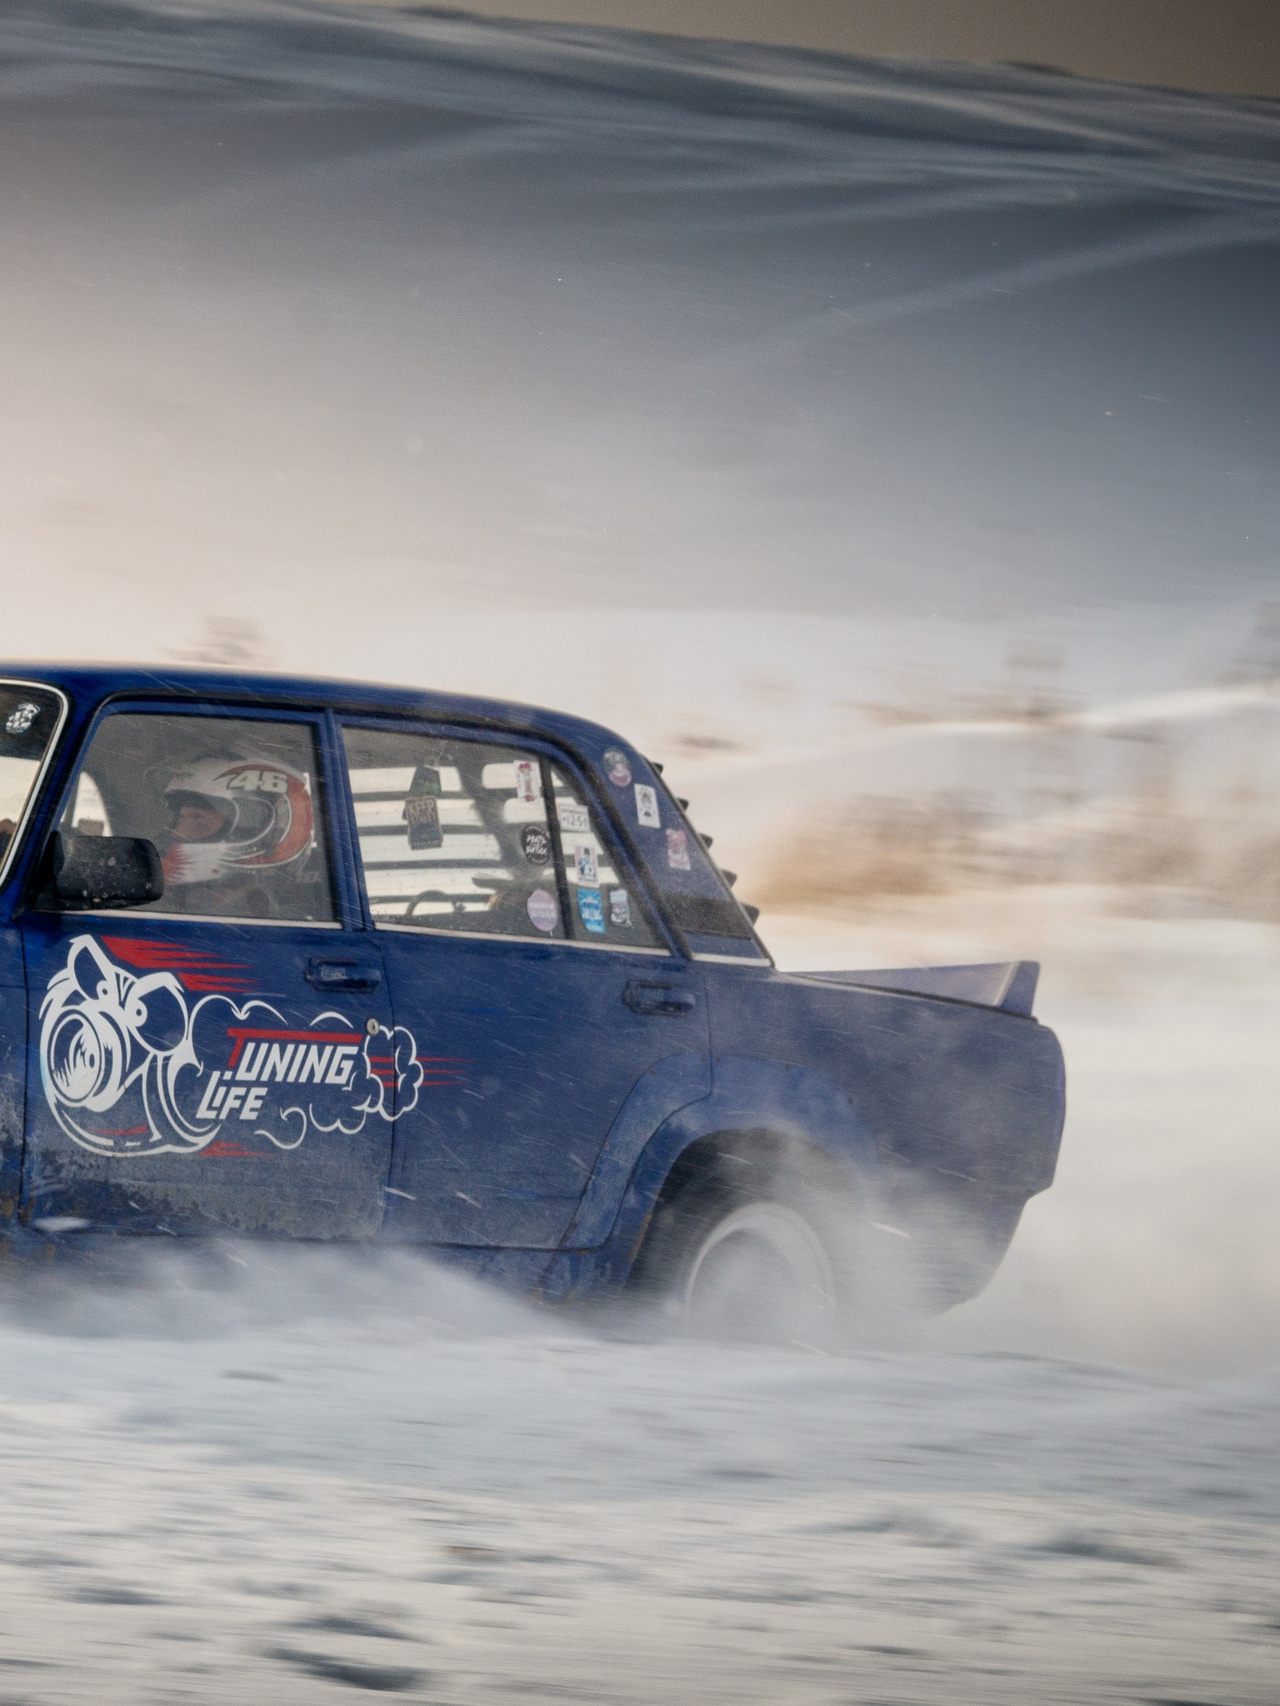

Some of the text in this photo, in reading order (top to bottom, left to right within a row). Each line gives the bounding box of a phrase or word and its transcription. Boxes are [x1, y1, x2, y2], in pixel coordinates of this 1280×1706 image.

[229, 770, 288, 793] 46
[227, 1028, 363, 1085] TUNING
[196, 1071, 269, 1120] LIFE
